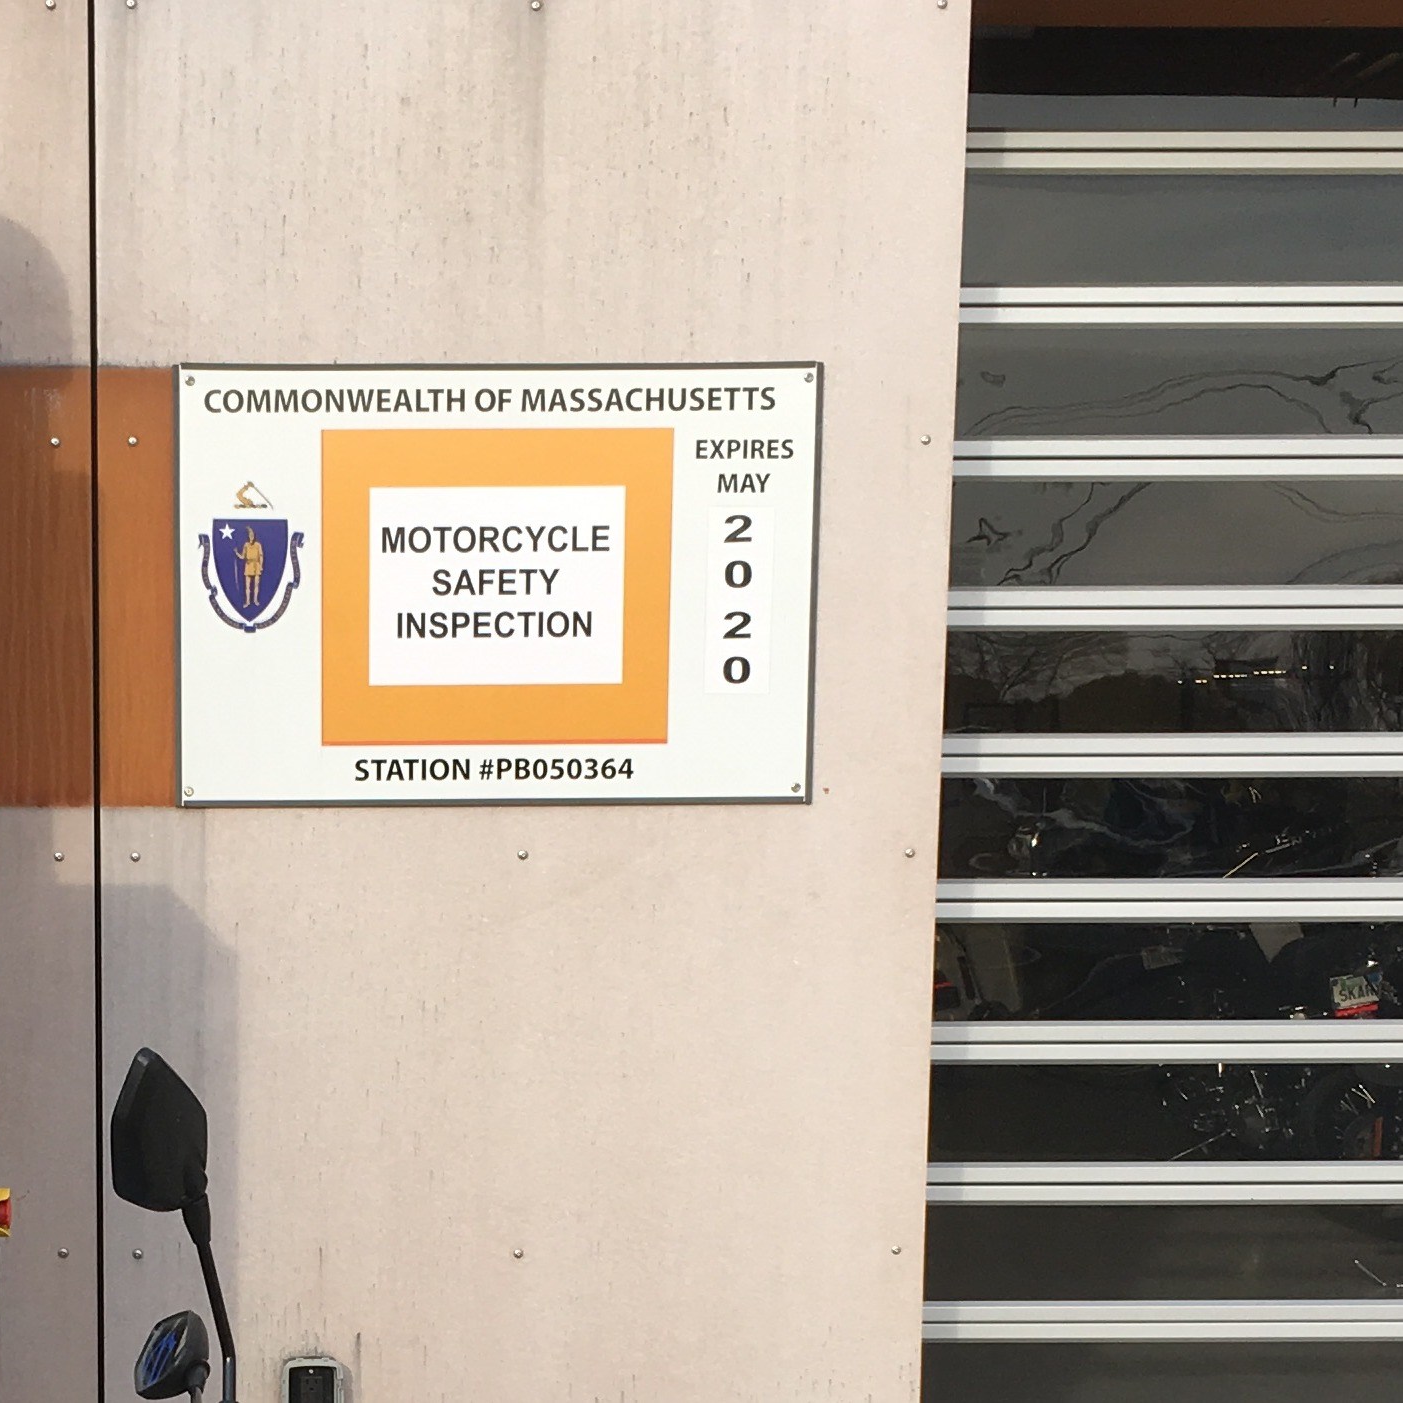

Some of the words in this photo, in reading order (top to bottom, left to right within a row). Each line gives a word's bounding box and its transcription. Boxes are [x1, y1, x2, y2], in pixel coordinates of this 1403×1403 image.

[204, 387, 466, 413] COMMONWEALTH
[474, 388, 512, 412] OF
[521, 386, 776, 412] MASSACHUSETTS
[695, 439, 794, 460] EXPIRES
[717, 473, 771, 494] MAY
[381, 525, 610, 554] MOTORCYCLE
[432, 568, 560, 596] SAFETY
[397, 610, 592, 639] INSPECTION
[355, 758, 471, 782] STATION
[478, 758, 634, 782] #PB050364
